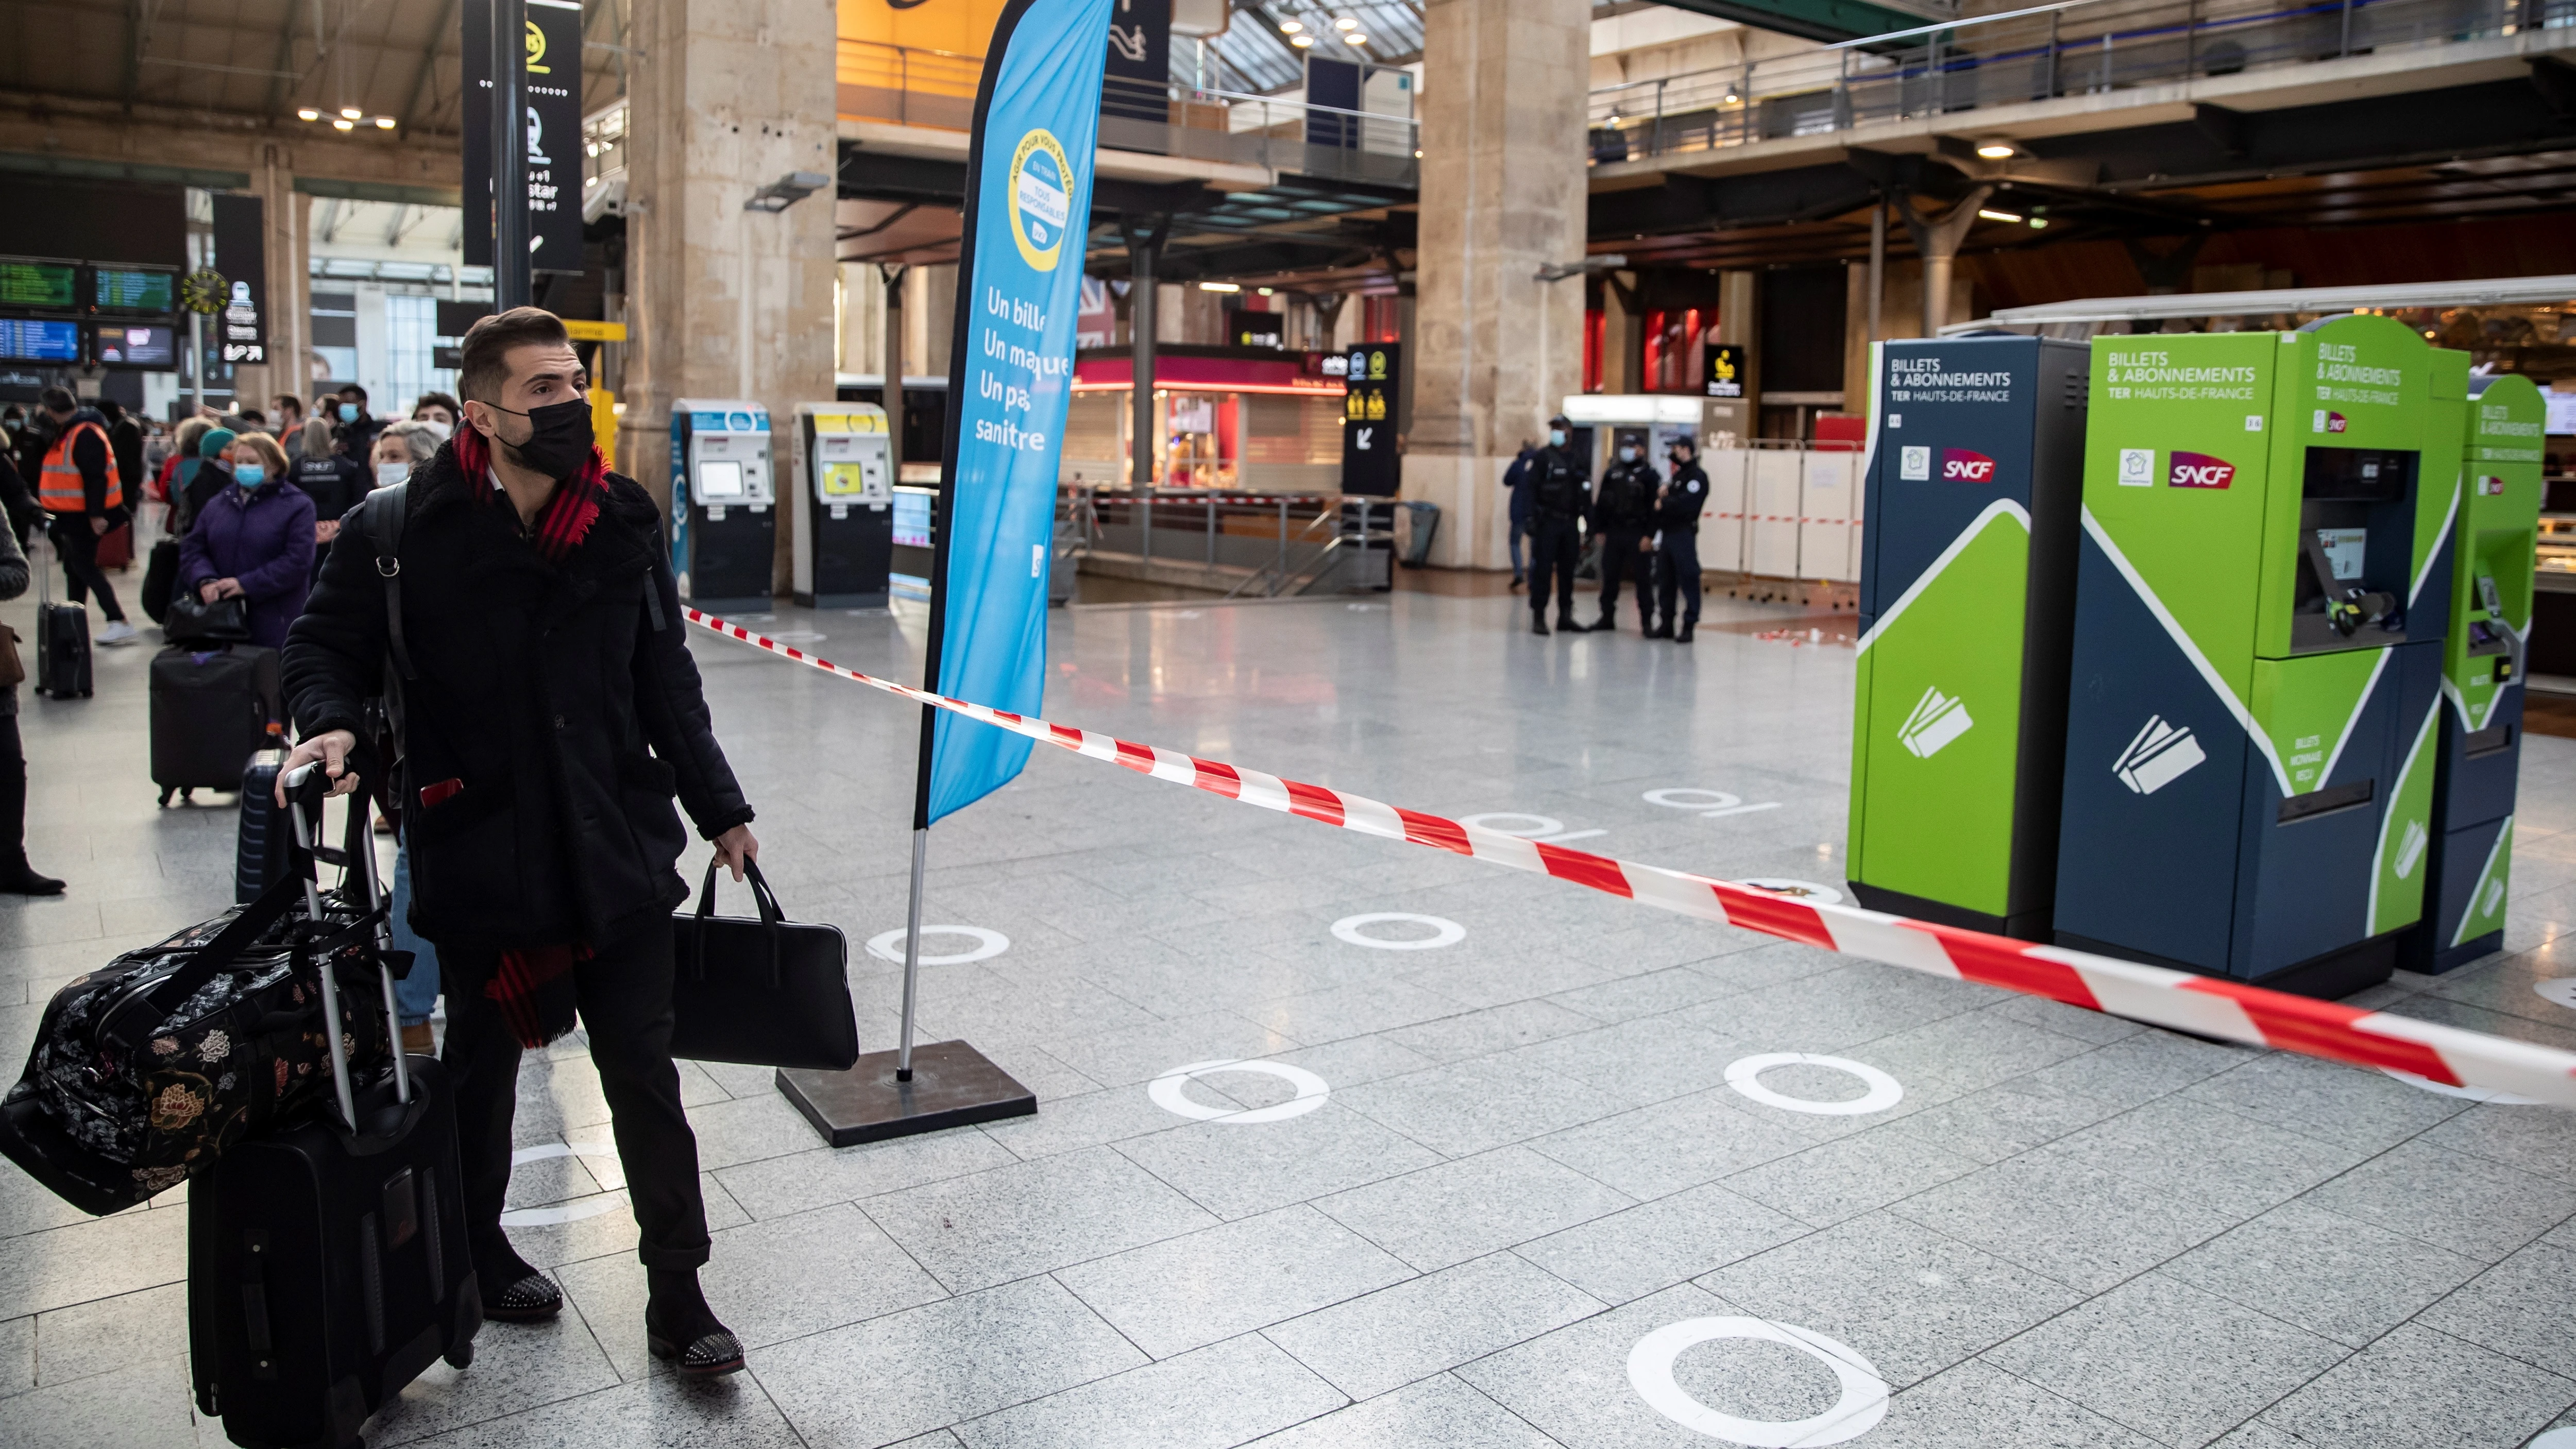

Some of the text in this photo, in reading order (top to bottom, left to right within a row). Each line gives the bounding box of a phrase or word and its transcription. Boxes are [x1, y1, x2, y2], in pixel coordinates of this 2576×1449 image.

[1022, 135, 1038, 155] POUR
[1040, 134, 1055, 152] VOUS
[988, 285, 1009, 320] Un
[984, 327, 1006, 361] Un
[2318, 343, 2357, 363] BILLETS
[1891, 358, 1940, 372] BILLETS
[2109, 351, 2168, 366] BILLETS
[1890, 372, 2011, 387] & ABONNEMENTS
[2107, 367, 2256, 382] & ABONNEMENTS
[980, 369, 1003, 402] Un
[2108, 387, 2254, 400] TER HAUTS-DE-FRANCE
[1891, 390, 2010, 402] TER HAUTS-DE-FRANCE
[1943, 461, 1993, 479] SNCF
[2171, 465, 2232, 485] SNCF
